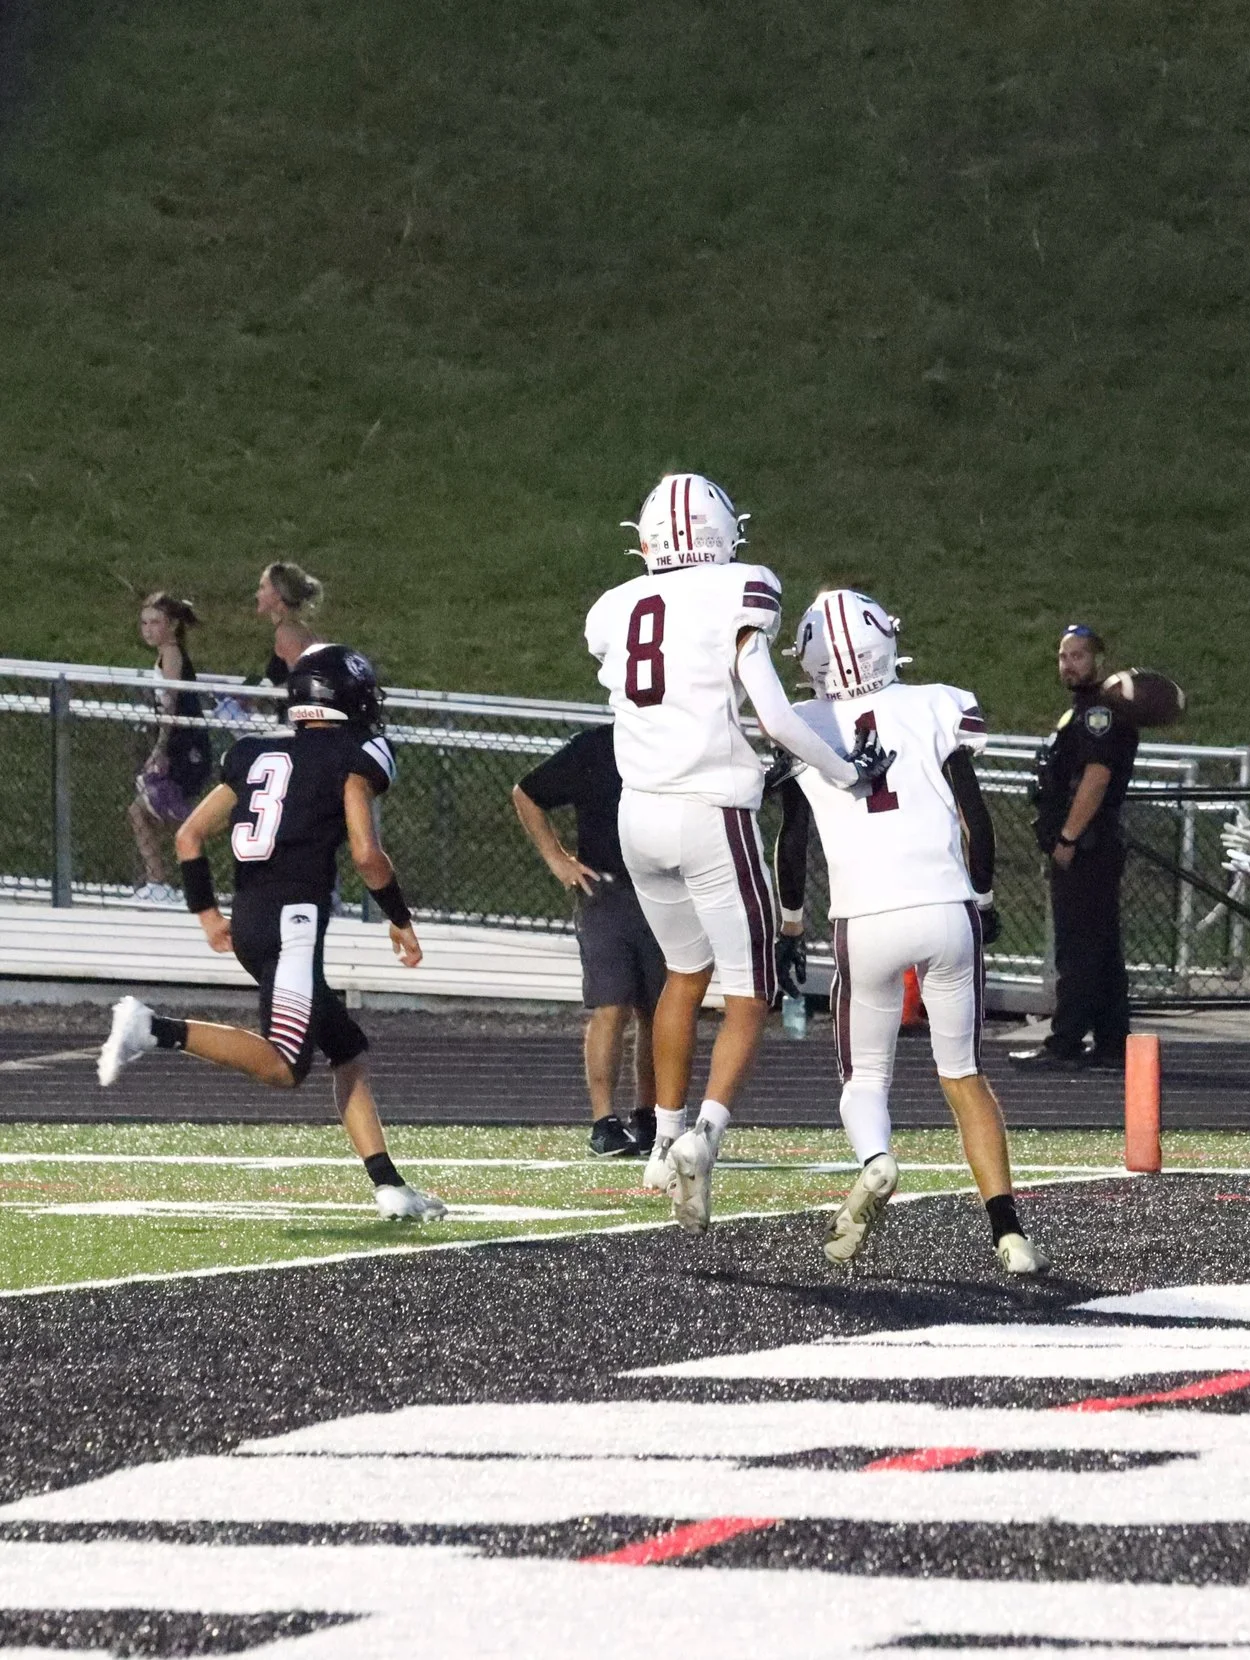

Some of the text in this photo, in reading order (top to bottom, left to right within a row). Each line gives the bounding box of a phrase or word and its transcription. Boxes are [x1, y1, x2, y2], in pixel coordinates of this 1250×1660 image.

[663, 540, 669, 549] 8
[656, 552, 716, 566] THE VALLEY
[625, 594, 666, 708] 8
[825, 680, 884, 700] THE VALLEY
[231, 751, 294, 862] 3
